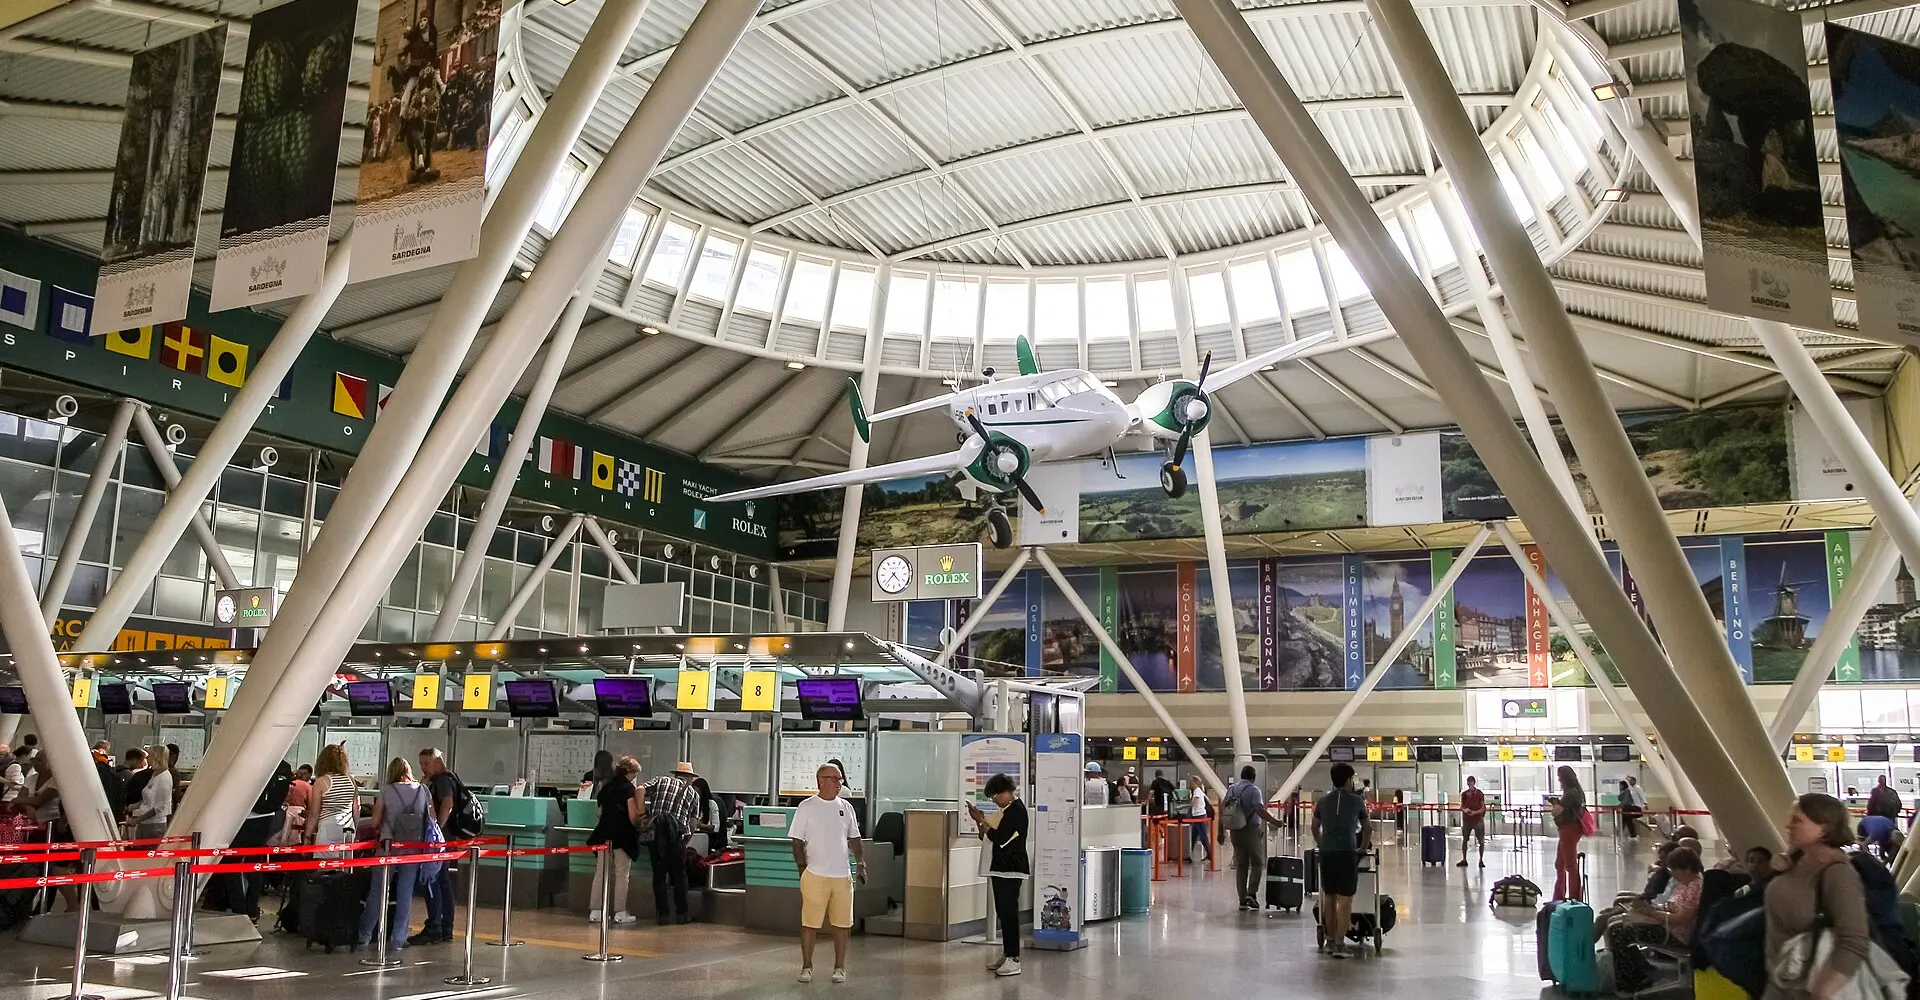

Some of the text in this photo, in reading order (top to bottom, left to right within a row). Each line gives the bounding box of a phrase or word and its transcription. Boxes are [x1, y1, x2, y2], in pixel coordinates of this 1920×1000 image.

[391, 246, 431, 260] SARDEGNA
[248, 279, 283, 292] SARDEGNA
[1751, 296, 1791, 310] SARDEGNA
[122, 305, 152, 318] SARDEGNA
[682, 478, 697, 489] MAXI
[698, 484, 718, 496] YACHT
[682, 488, 703, 500] ROLEX
[732, 517, 768, 539] ROLEX
[924, 572, 970, 586] ROLEX
[1729, 560, 1744, 640] BERLINO
[243, 608, 268, 618] ROLEX
[1182, 583, 1190, 653] COLONIA
[1264, 564, 1273, 668] BARCELLONA
[1348, 565, 1359, 661] EDIMBURGO
[1030, 604, 1038, 642] OSLO
[79, 689, 83, 698] 2
[213, 688, 218, 698] 3
[423, 686, 428, 697] 5
[474, 687, 480, 697] 6
[690, 684, 697, 696] 7
[755, 685, 762, 697] 8
